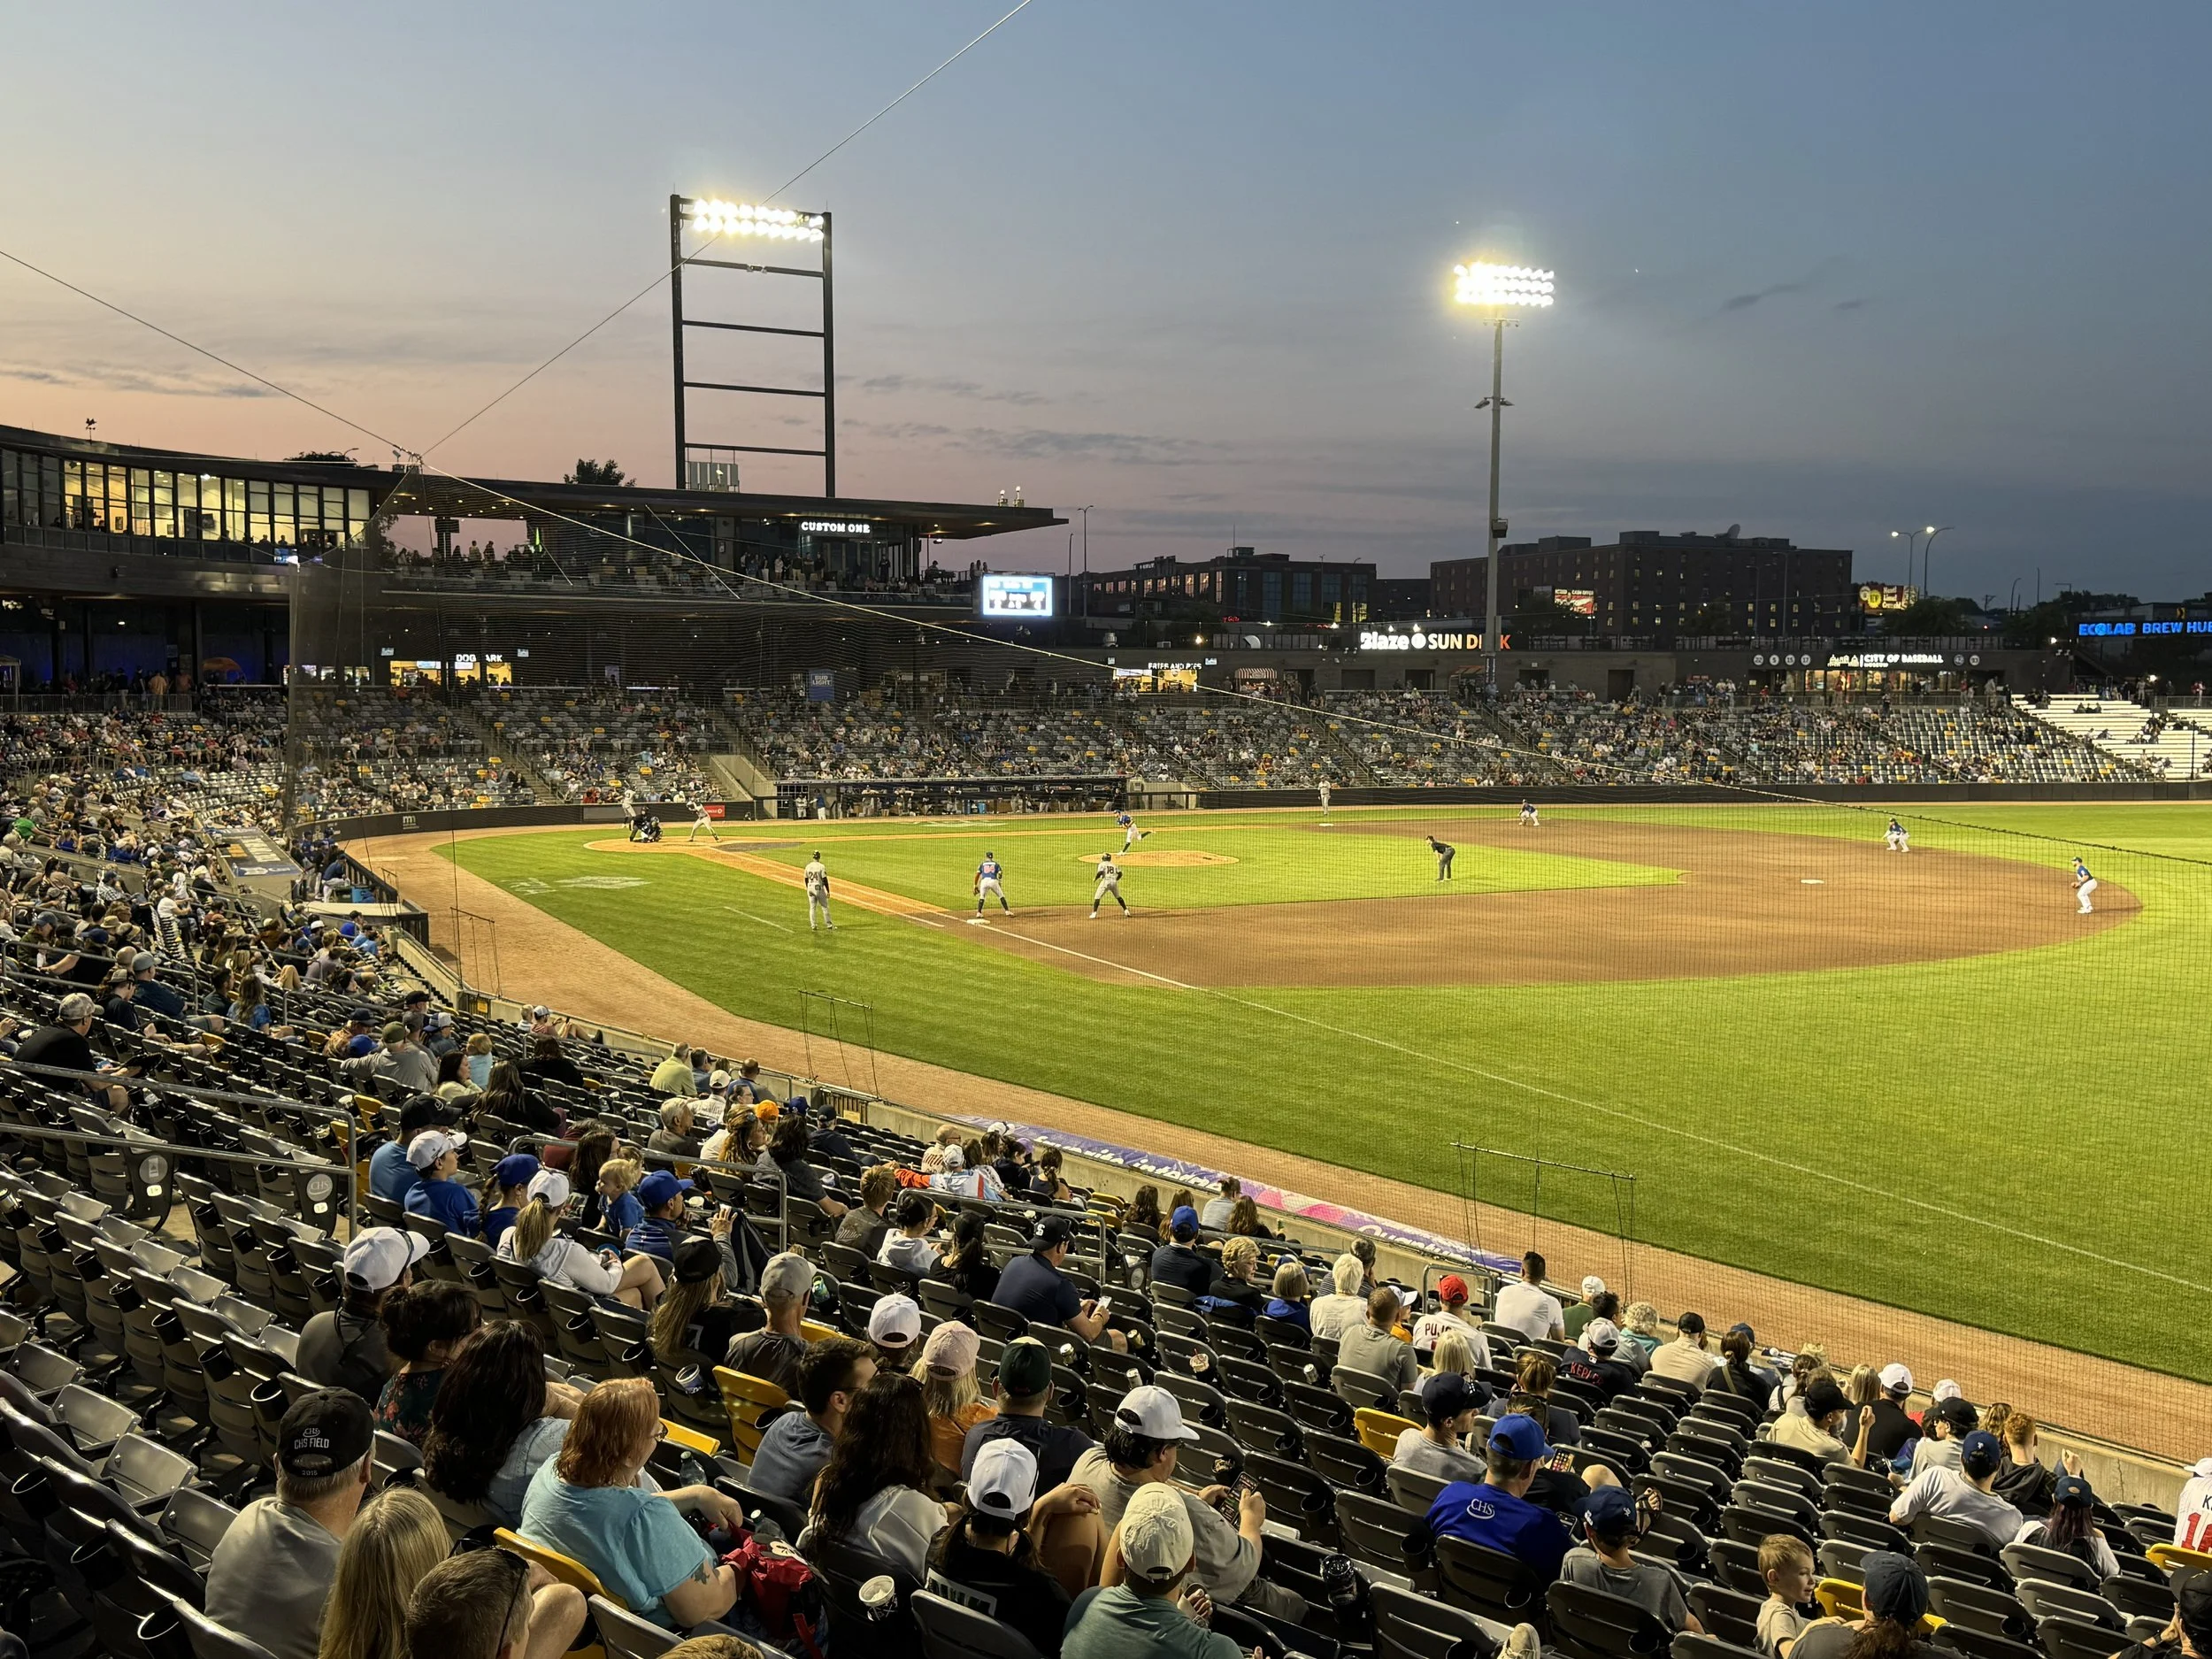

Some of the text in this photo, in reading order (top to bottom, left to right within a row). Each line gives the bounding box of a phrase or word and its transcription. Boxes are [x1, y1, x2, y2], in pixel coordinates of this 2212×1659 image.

[801, 521, 871, 534] CUSTOM ONE
[2079, 623, 2136, 636] ECOLAB
[2142, 622, 2183, 634] BREW
[1360, 631, 1511, 650] Blaze SUN DK
[456, 654, 476, 663] DOG
[1864, 654, 1944, 664] CITY OF BASEBALL
[808, 871, 818, 881] 24
[1106, 865, 1115, 874] 18
[294, 1437, 330, 1450] CHS FIELD
[1470, 1498, 1494, 1516] CHS
